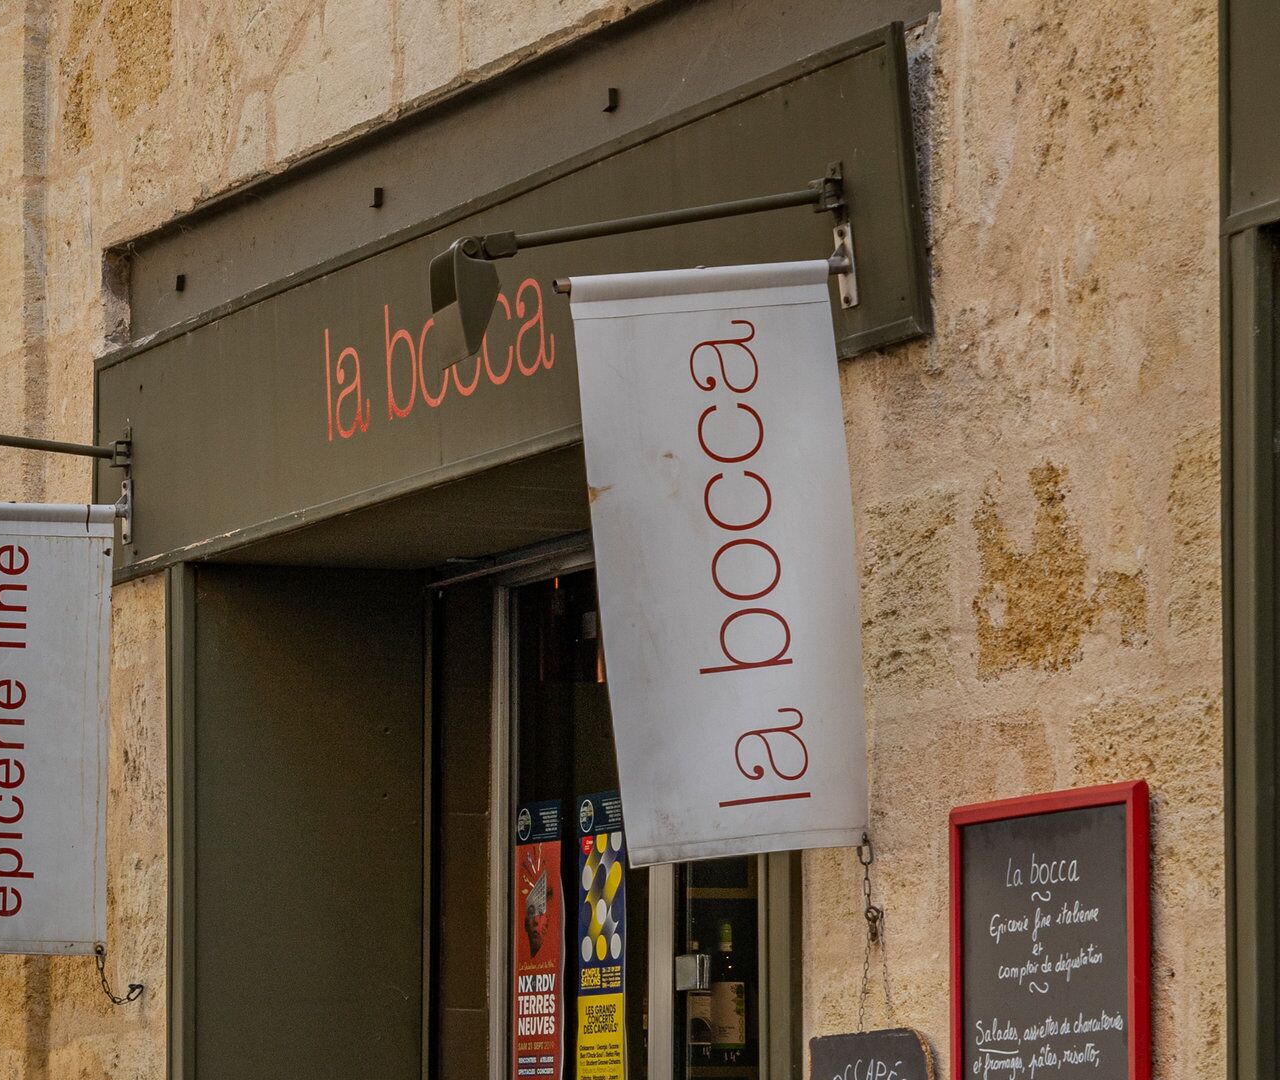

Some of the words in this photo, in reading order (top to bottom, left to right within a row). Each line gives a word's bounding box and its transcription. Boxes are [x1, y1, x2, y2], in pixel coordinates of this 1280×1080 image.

[324, 328, 371, 442] la
[689, 319, 794, 675] bocca
[718, 707, 812, 809] la
[1006, 858, 1023, 887] La
[1030, 853, 1080, 885] bocca
[1032, 907, 1051, 941] fine
[1032, 942, 1044, 956] et
[998, 961, 1039, 985] comptoir
[1041, 955, 1052, 973] de
[1055, 944, 1103, 982] dégustation
[518, 975, 533, 993] NX
[536, 973, 556, 992] RDV
[518, 994, 556, 1015] TERRES
[585, 1005, 594, 1016] LES
[595, 1004, 617, 1015] GRANDS
[518, 1015, 555, 1036] NEUVES
[584, 1024, 593, 1035] DES
[587, 1014, 615, 1025] CONCERTS
[1023, 1015, 1059, 1041] assiettes
[1060, 1017, 1071, 1035] de
[973, 1056, 982, 1074] et
